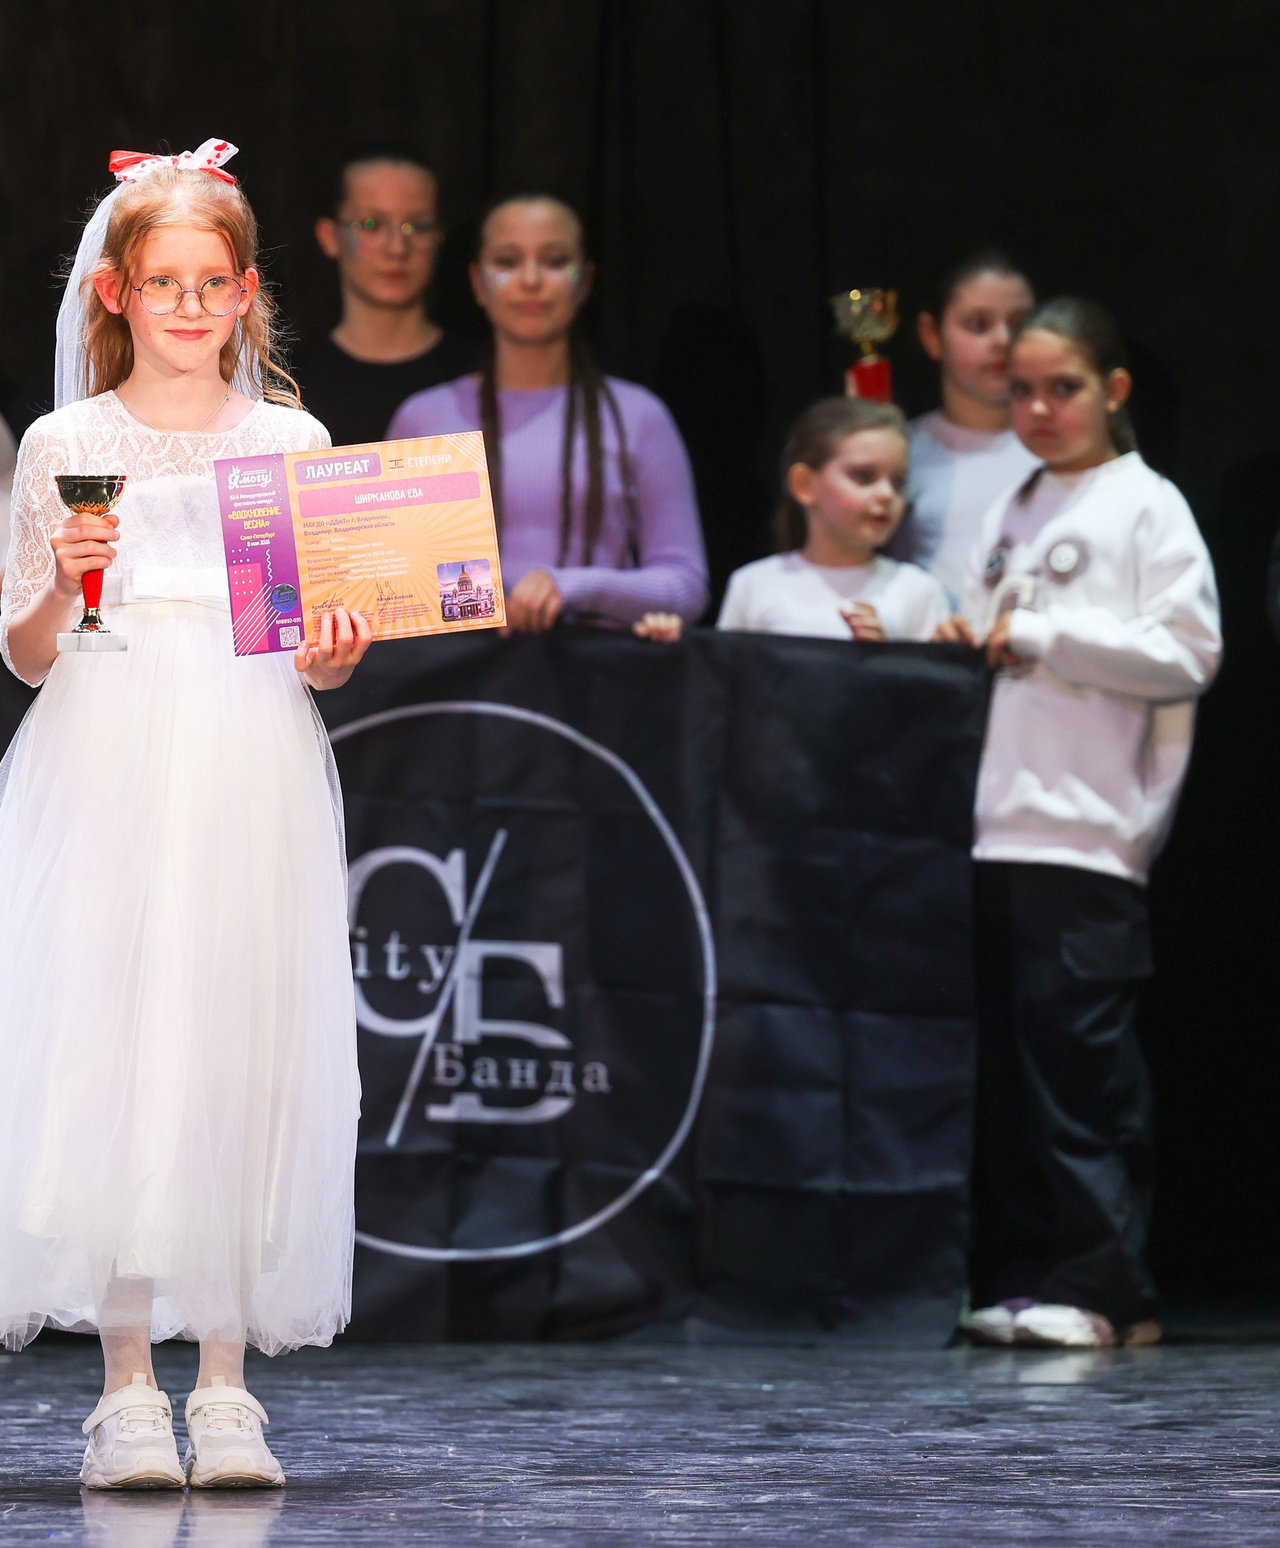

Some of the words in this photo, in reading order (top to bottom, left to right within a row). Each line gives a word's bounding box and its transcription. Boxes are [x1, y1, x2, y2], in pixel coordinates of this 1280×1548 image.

[305, 459, 370, 480] ЛАУРЕАТ
[408, 454, 452, 468] СТЕПЕНИ
[354, 489, 406, 504] ШИРКАНОВА
[407, 488, 423, 499] ЕВА
[243, 519, 270, 530] ВЕСНА»
[334, 524, 373, 533] Владимирская
[374, 521, 396, 529] область
[432, 1042, 612, 1093] Банда
